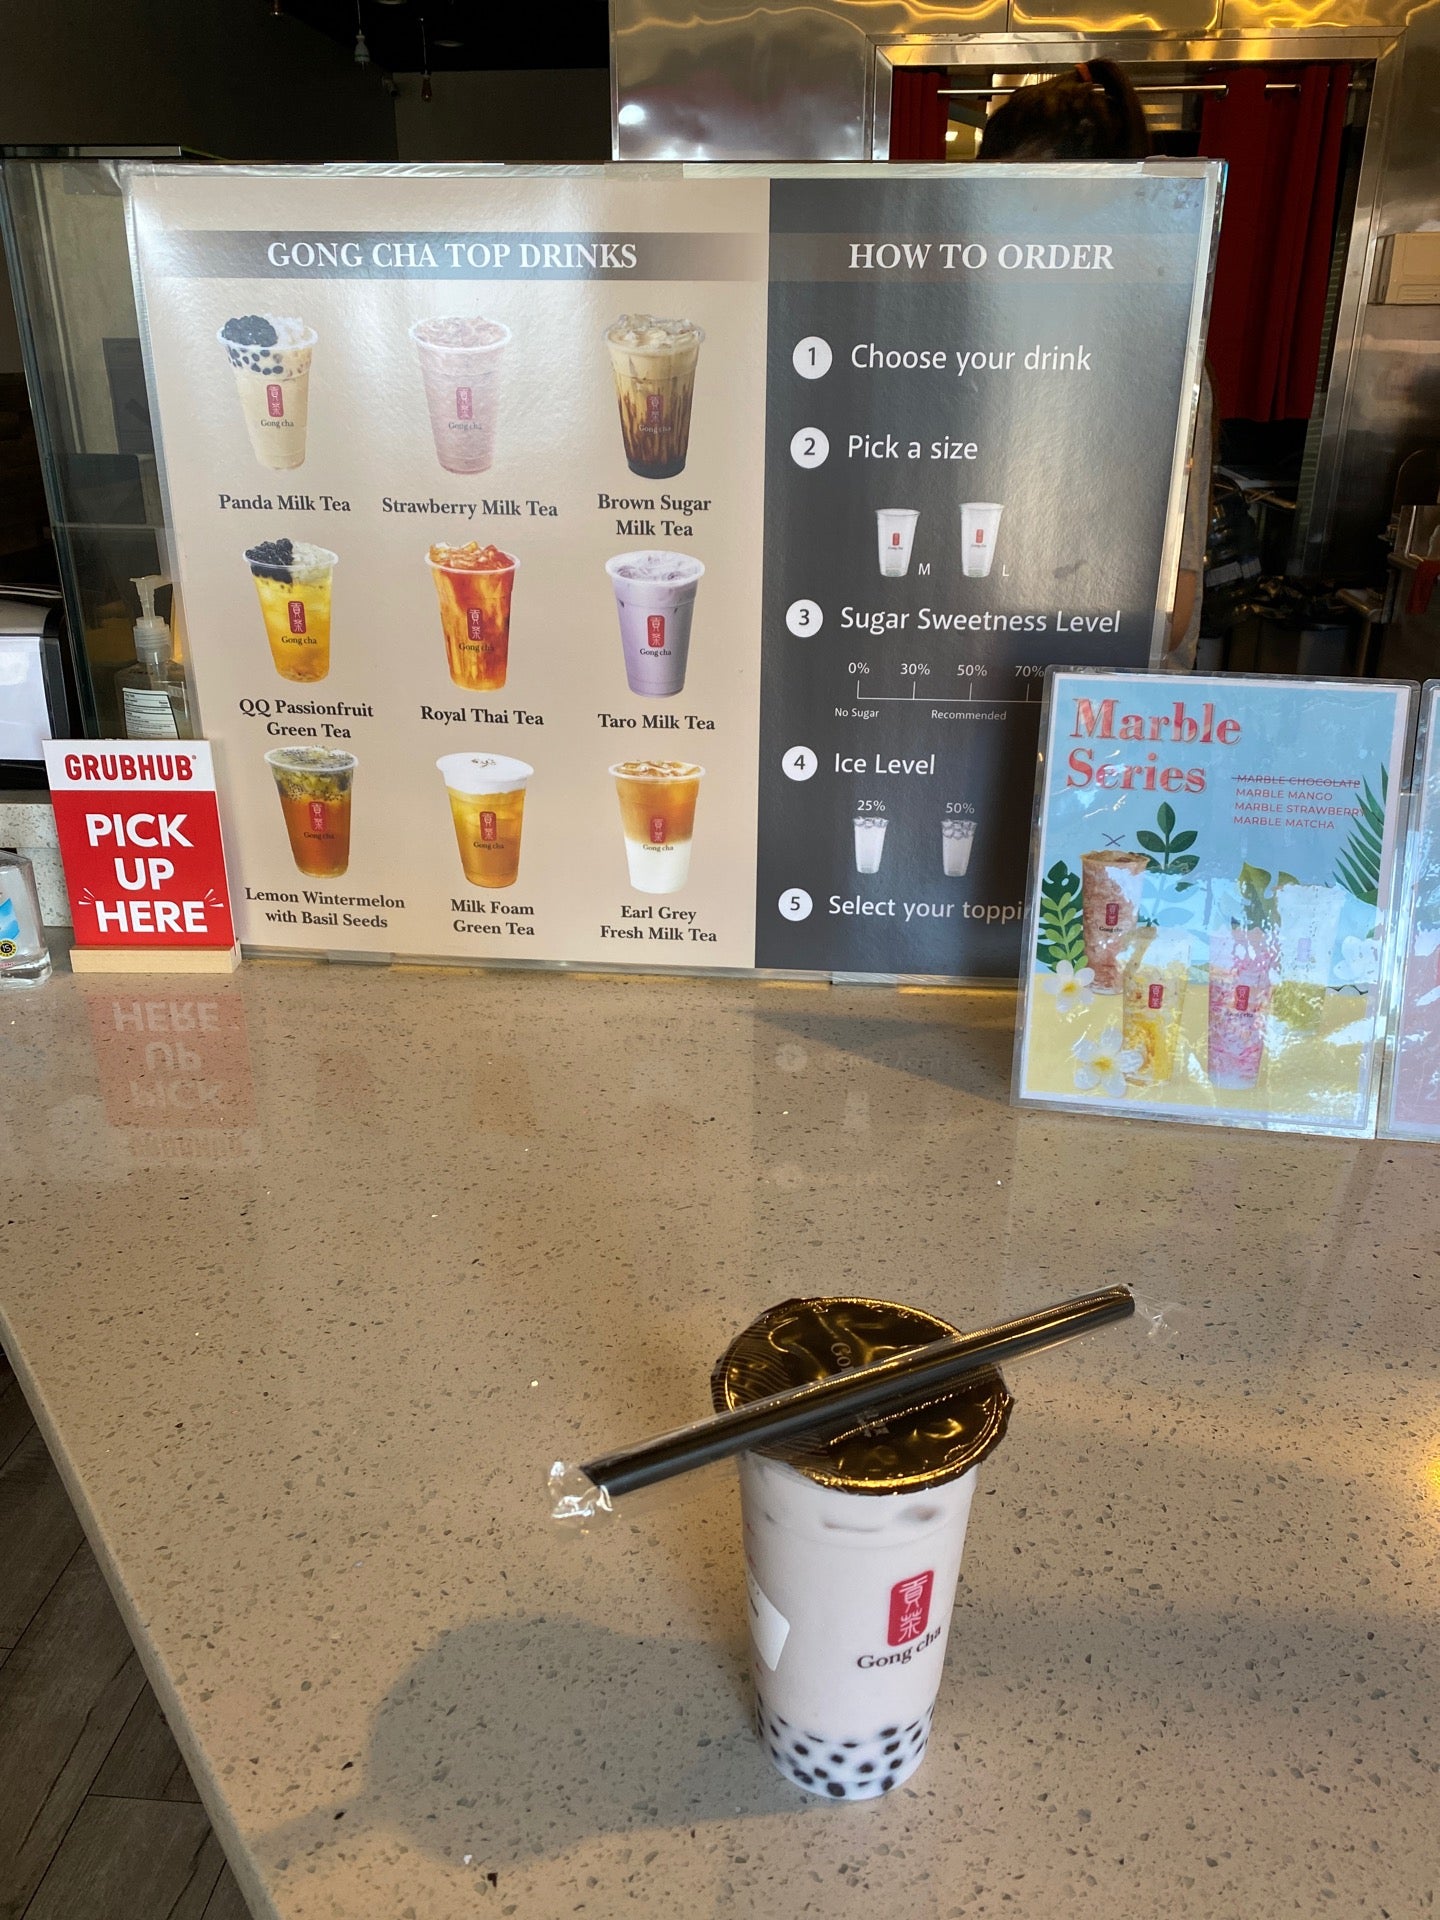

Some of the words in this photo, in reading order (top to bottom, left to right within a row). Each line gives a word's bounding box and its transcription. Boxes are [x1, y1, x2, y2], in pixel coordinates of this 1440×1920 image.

[267, 242, 363, 267] GONG
[372, 243, 438, 267] CHA
[445, 243, 510, 268] TOP
[520, 243, 637, 269] DRINKS
[848, 243, 932, 269] HOW
[940, 244, 987, 269] TO
[998, 244, 1114, 270] ORDER
[808, 347, 817, 366] 1
[851, 343, 947, 369] Choose
[956, 349, 1016, 376] your
[1024, 345, 1091, 371] drink
[260, 419, 281, 429] Gong
[282, 418, 294, 427] cha
[639, 424, 658, 434] Gong
[804, 438, 816, 456] 2
[849, 435, 898, 459] Pick
[907, 441, 921, 459] a
[931, 436, 978, 460] size
[218, 494, 272, 510] Panda
[277, 495, 316, 511] Milk
[320, 496, 351, 512] Tea
[382, 497, 477, 521] Strawberry
[482, 499, 521, 516] Milk
[526, 500, 558, 516] Tea
[597, 493, 655, 511] Brown
[660, 494, 712, 516] Sugar
[616, 519, 655, 535] Milk
[661, 520, 694, 536] Tea
[918, 562, 931, 576] M
[1002, 564, 1010, 577] L
[798, 609, 810, 626] 3
[841, 607, 909, 635] Sugar
[917, 608, 1047, 632] Sweetness
[1056, 610, 1121, 633] Level
[281, 635, 303, 646] Gong
[304, 636, 317, 645] cha
[458, 642, 480, 652] Gong
[639, 648, 659, 657] Gong
[848, 662, 870, 674] 0%
[900, 663, 930, 676] 30%
[957, 664, 988, 677] 50%
[1015, 665, 1045, 677] 70%
[239, 699, 271, 717] QQ
[275, 700, 374, 717] Passionfruit
[420, 705, 466, 726] Royal
[471, 708, 509, 724] Thai
[513, 710, 544, 726] Tea
[834, 707, 849, 717] No
[851, 708, 879, 720] Sugar
[931, 709, 1007, 721] Recommended
[266, 722, 317, 738] Green
[321, 723, 351, 738] Tea
[598, 713, 637, 729] Taro
[641, 714, 680, 730] Milk
[685, 715, 715, 731] Tea
[1068, 698, 1242, 745] Marble
[793, 755, 805, 770] 4
[834, 753, 867, 774] Ice
[875, 754, 935, 776] Level
[1066, 747, 1208, 793] Series
[1237, 774, 1286, 786] MARBLE
[1288, 776, 1361, 789] CHOCOLATE
[1236, 788, 1285, 799] MARBLE
[1288, 791, 1333, 802] MANGO
[857, 800, 886, 812] 25%
[945, 802, 975, 815] 50%
[1235, 802, 1283, 813] MARBLE
[85, 813, 194, 848] PICK
[1233, 816, 1281, 827] MARBLE
[1285, 819, 1335, 830] MATCHA
[642, 844, 661, 853] Gong
[113, 857, 175, 891] UP
[245, 887, 299, 904] Lemon
[302, 891, 405, 909] Wintermelon
[451, 898, 486, 914] Milk
[490, 900, 534, 916] Foam
[95, 900, 208, 933] HERE
[265, 910, 297, 923] with
[301, 911, 338, 926] Basil
[342, 913, 388, 928] Seeds
[621, 905, 653, 919] Earl
[658, 906, 697, 923] Grey
[791, 897, 800, 910] 5
[828, 895, 896, 917] Select
[903, 902, 955, 922] your
[962, 901, 1023, 925] toppi
[453, 919, 501, 934] Green
[505, 921, 535, 936] Tea
[600, 925, 643, 940] Fresh
[648, 926, 684, 941] Milk
[688, 928, 717, 942] Tea
[857, 1647, 913, 1669] Gong
[916, 1625, 941, 1653] cha
